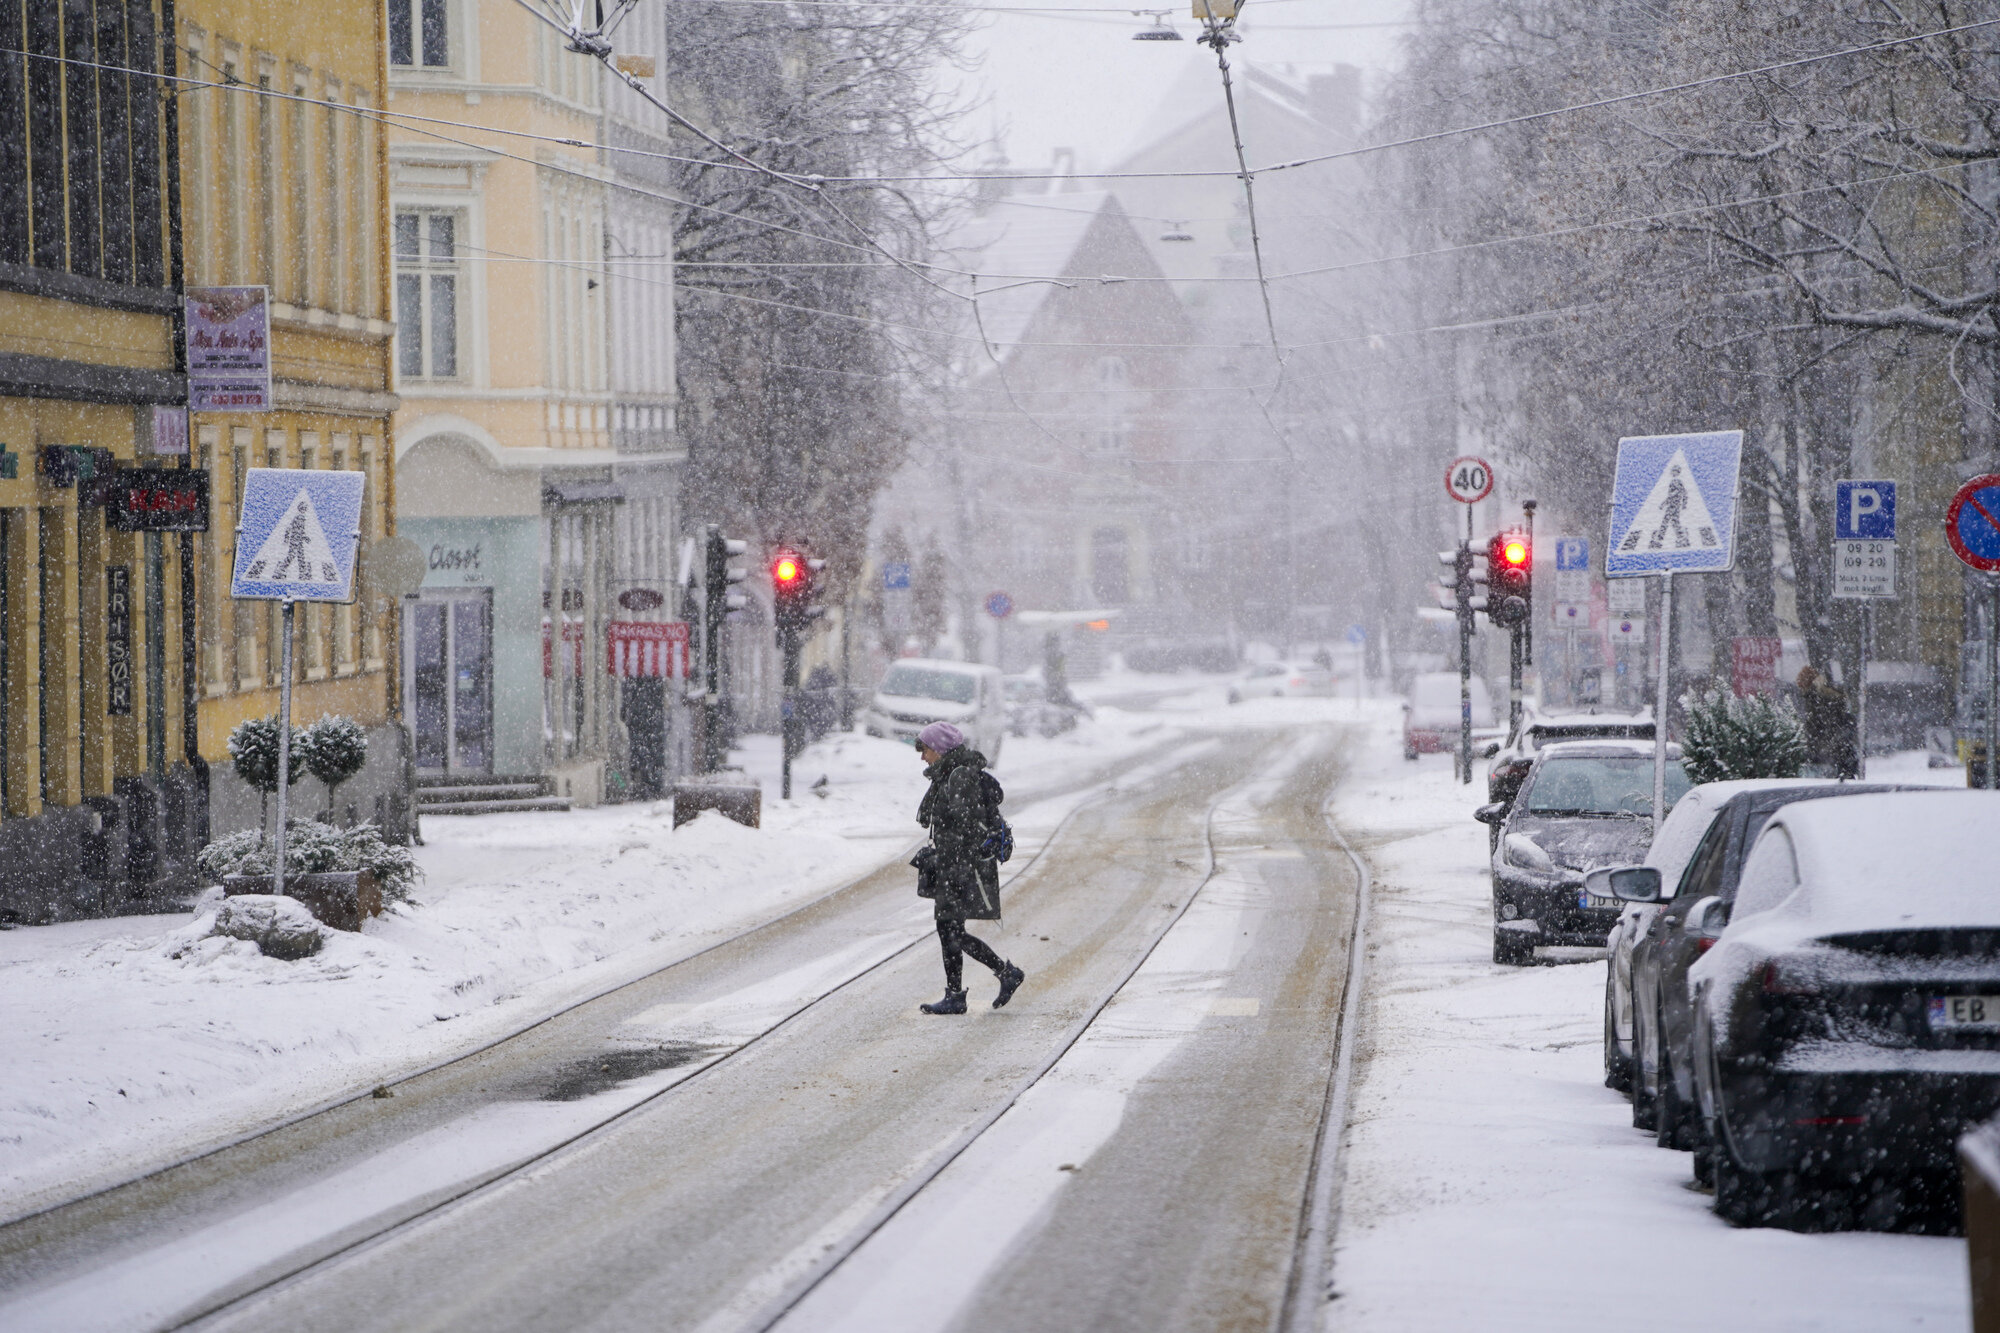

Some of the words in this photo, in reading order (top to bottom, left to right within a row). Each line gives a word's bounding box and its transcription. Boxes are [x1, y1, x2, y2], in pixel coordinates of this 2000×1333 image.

[1454, 467, 1485, 490] 40
[129, 489, 196, 511] KAM
[1850, 488, 1881, 531] P
[111, 570, 128, 706] FRISØR
[1953, 999, 1985, 1023] EB
